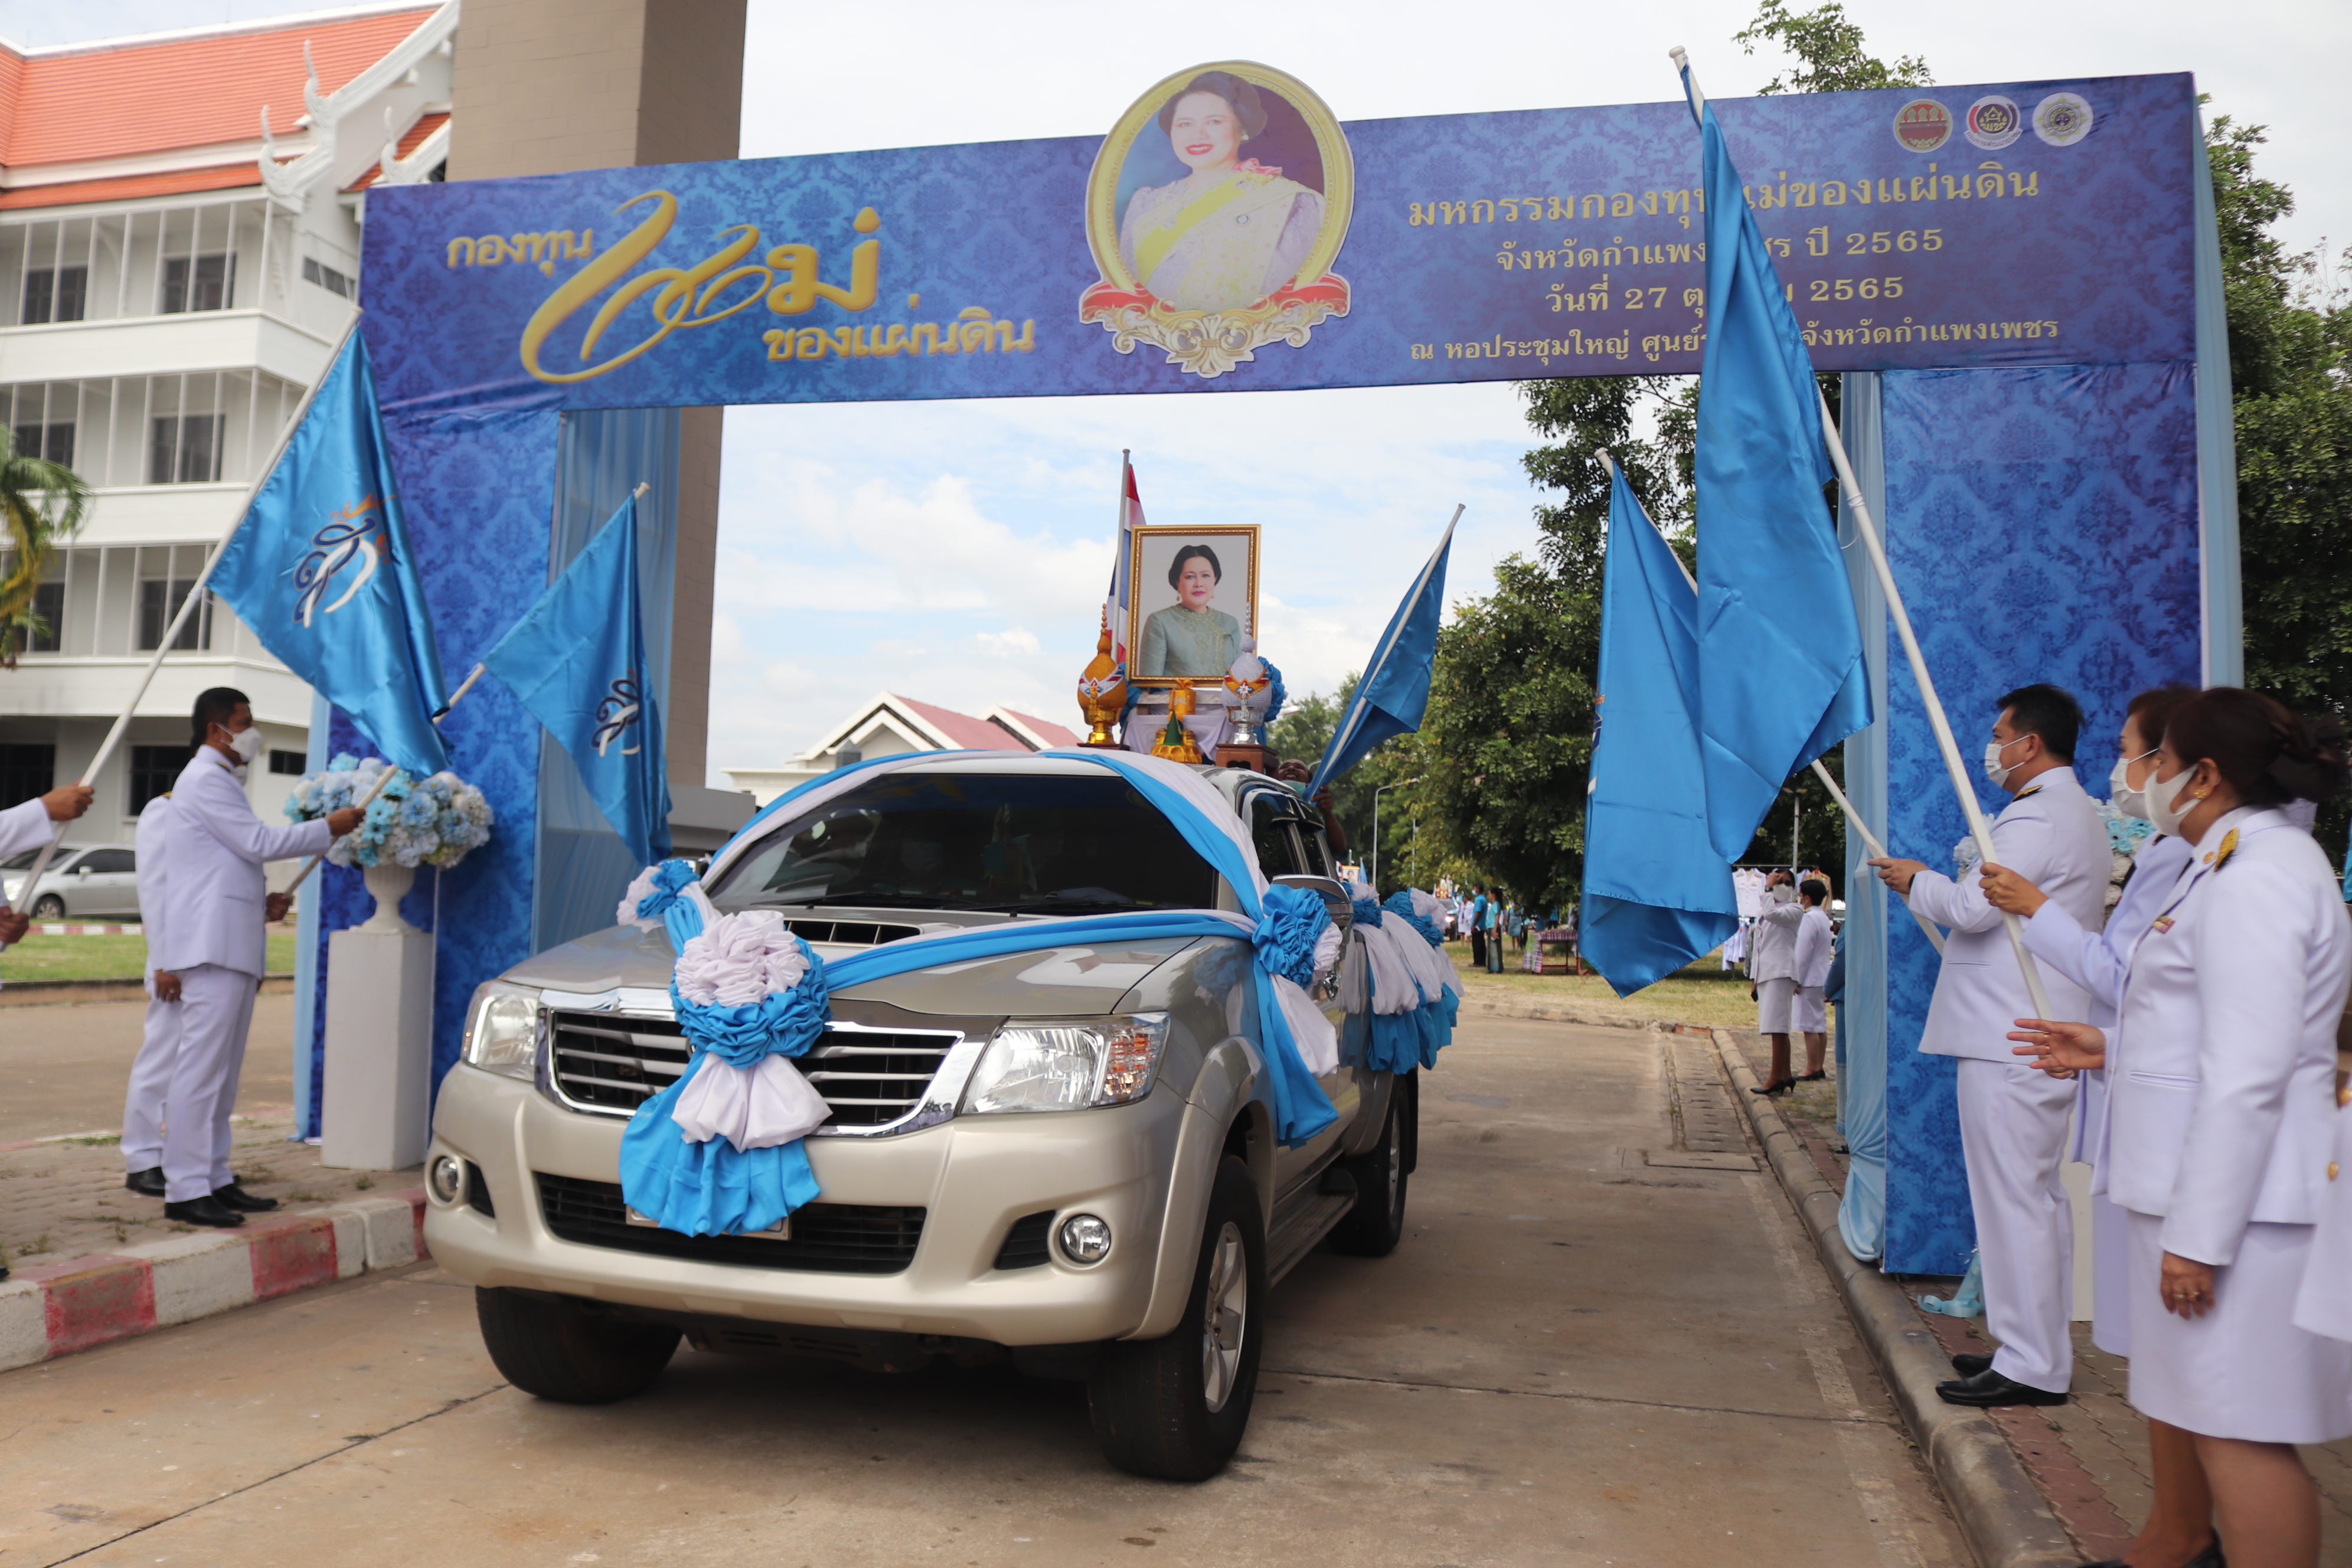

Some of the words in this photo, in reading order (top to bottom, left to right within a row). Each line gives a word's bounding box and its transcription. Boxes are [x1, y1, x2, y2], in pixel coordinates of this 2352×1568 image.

[447, 228, 593, 276] กองทุน
[1805, 226, 1829, 257] ปี
[1846, 228, 1943, 256] 2565
[1545, 274, 1609, 313] วันที่
[1625, 286, 1668, 311] 27
[1809, 276, 1904, 302] 2565
[762, 293, 1035, 361] ของแผ่นดิน
[1411, 344, 1434, 360] ณ
[1445, 329, 1629, 366] หอประชุมใหญ่
